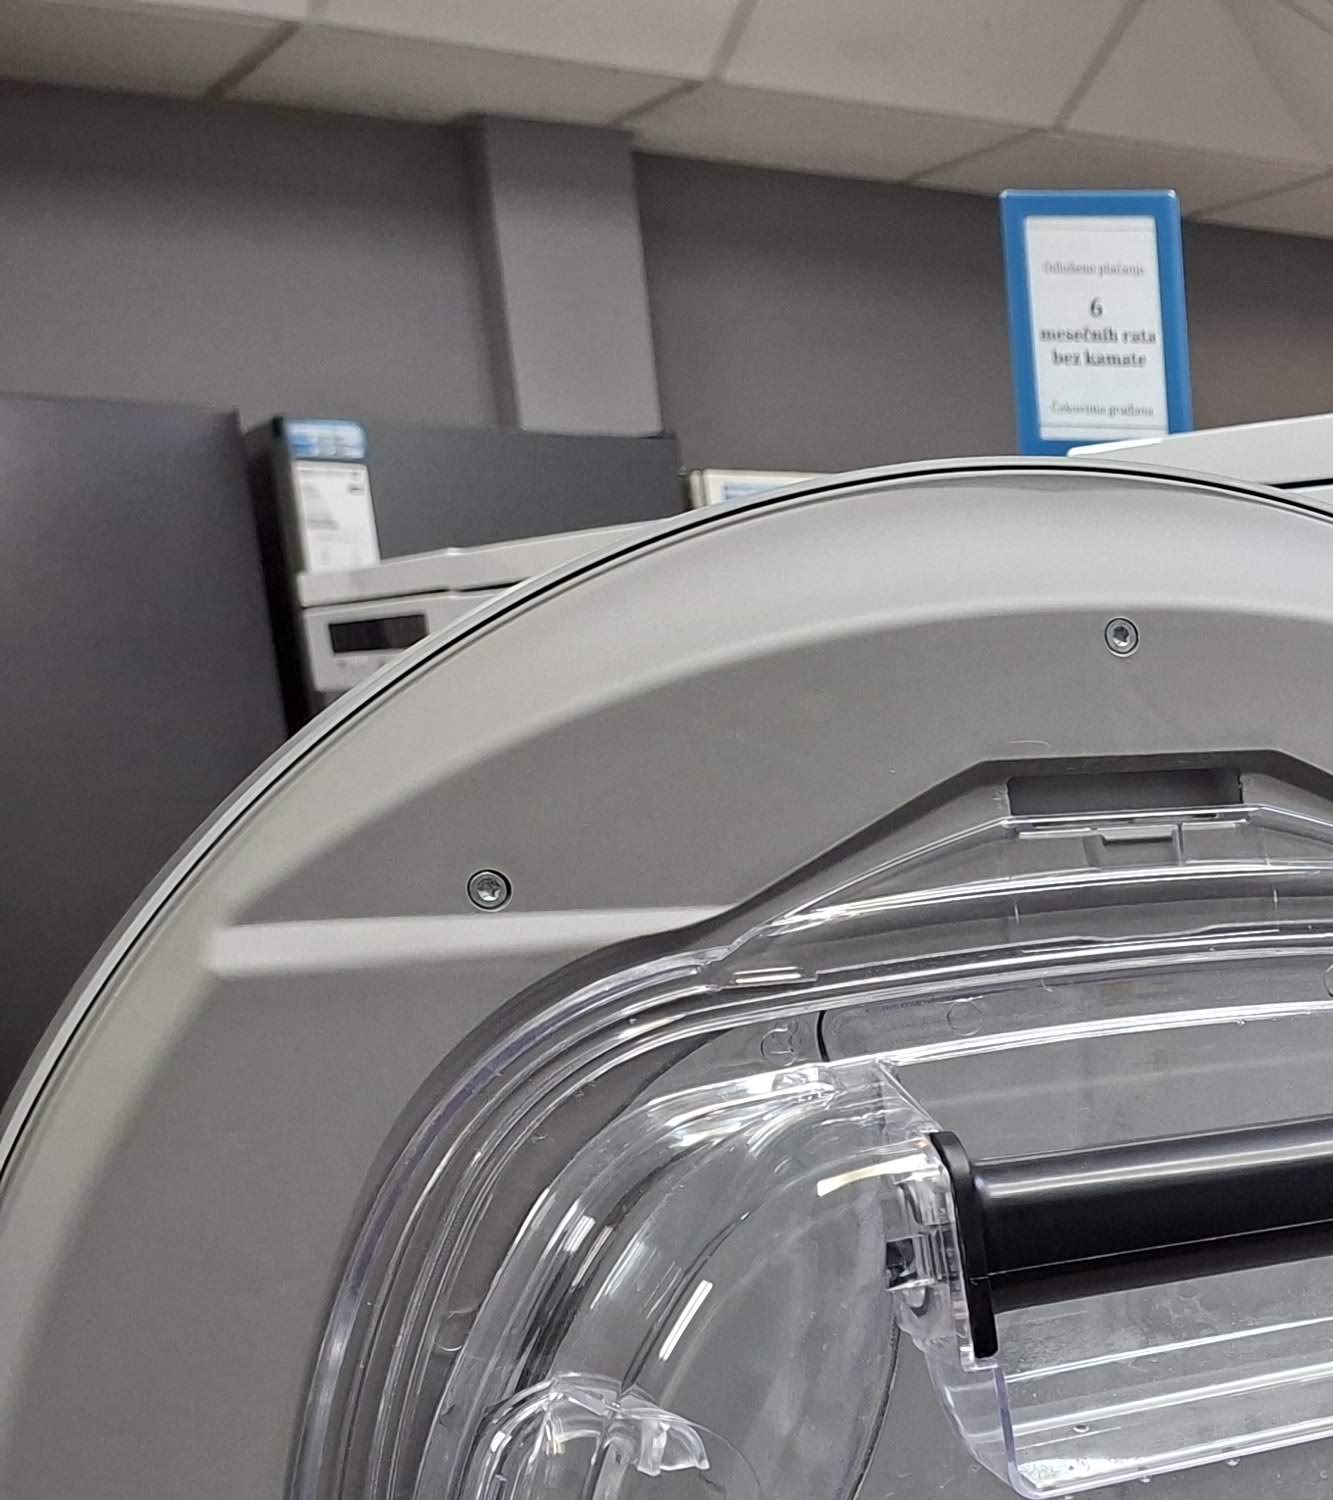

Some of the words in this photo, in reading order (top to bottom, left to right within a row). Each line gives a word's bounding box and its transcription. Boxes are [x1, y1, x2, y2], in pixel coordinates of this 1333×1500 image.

[1089, 297, 1103, 318] 6
[1123, 327, 1156, 344] rata
[1052, 351, 1081, 366] bez
[1086, 350, 1147, 368] kamate
